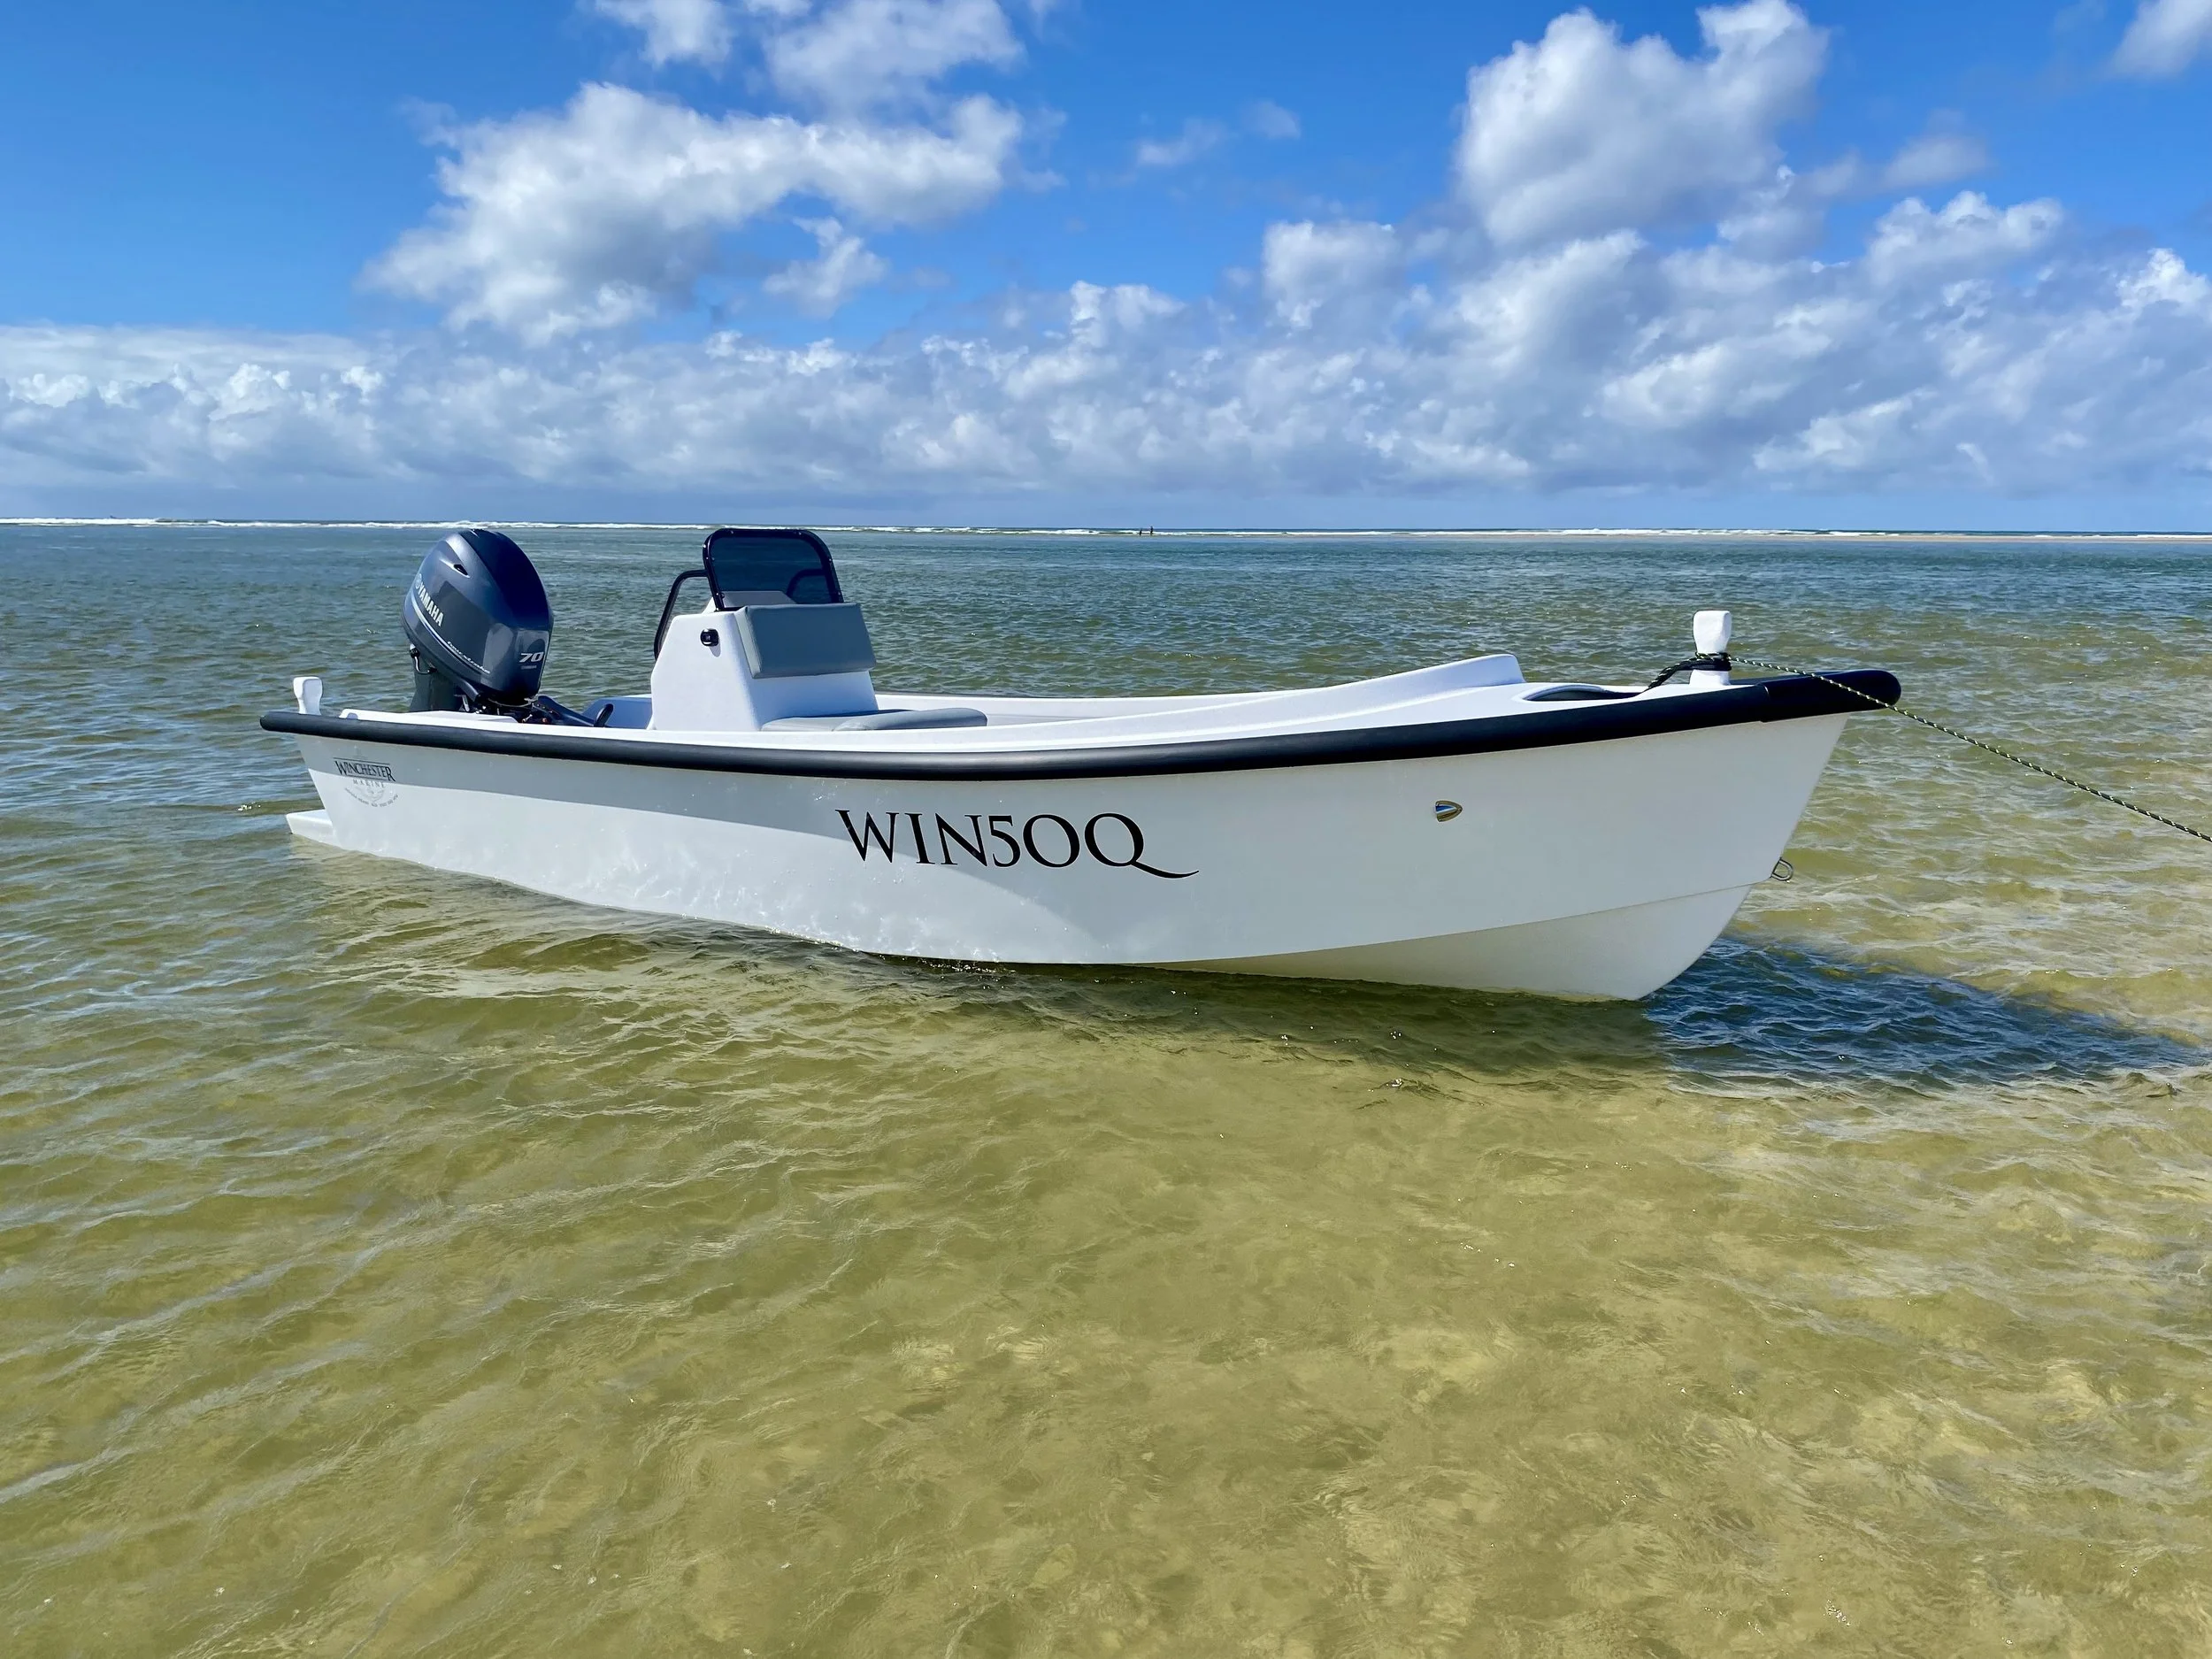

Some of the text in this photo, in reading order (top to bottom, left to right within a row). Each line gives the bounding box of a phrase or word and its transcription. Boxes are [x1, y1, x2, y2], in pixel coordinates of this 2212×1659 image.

[418, 581, 443, 626] YAMAHA
[519, 651, 544, 663] 70
[334, 761, 396, 781] WINCHESTER
